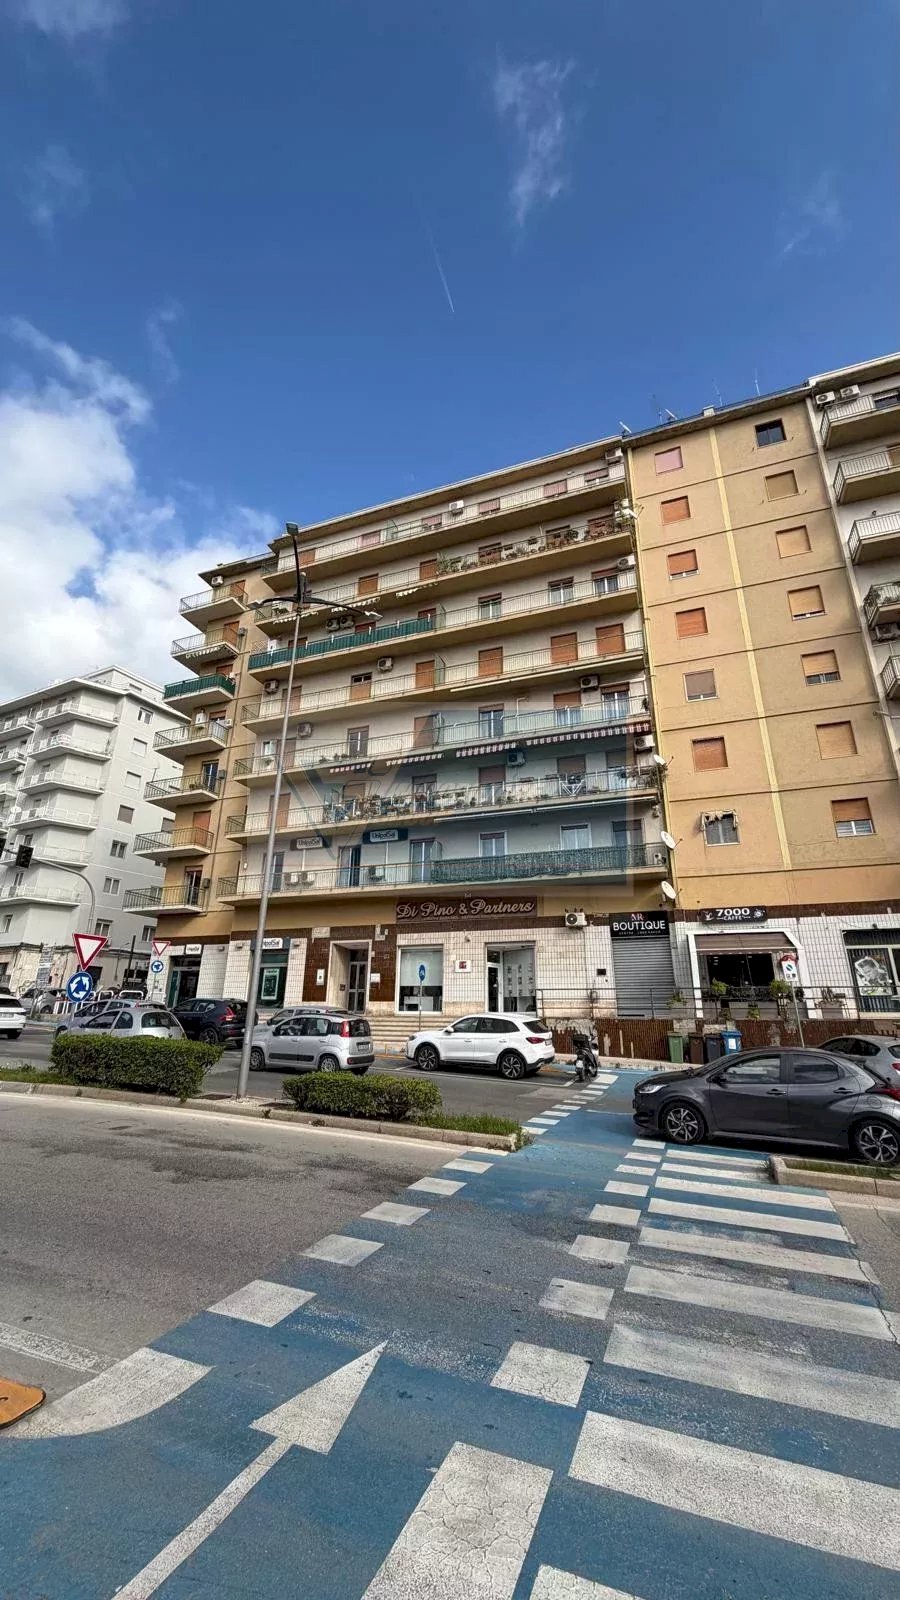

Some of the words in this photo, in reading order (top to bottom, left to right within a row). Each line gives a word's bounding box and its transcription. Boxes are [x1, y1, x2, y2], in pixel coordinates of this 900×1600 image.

[396, 903, 419, 918] Di
[420, 902, 456, 917] Pino
[459, 903, 468, 914] &
[470, 899, 534, 914] Partners
[716, 908, 750, 917] 7000
[612, 920, 666, 931] BOUTIQUE
